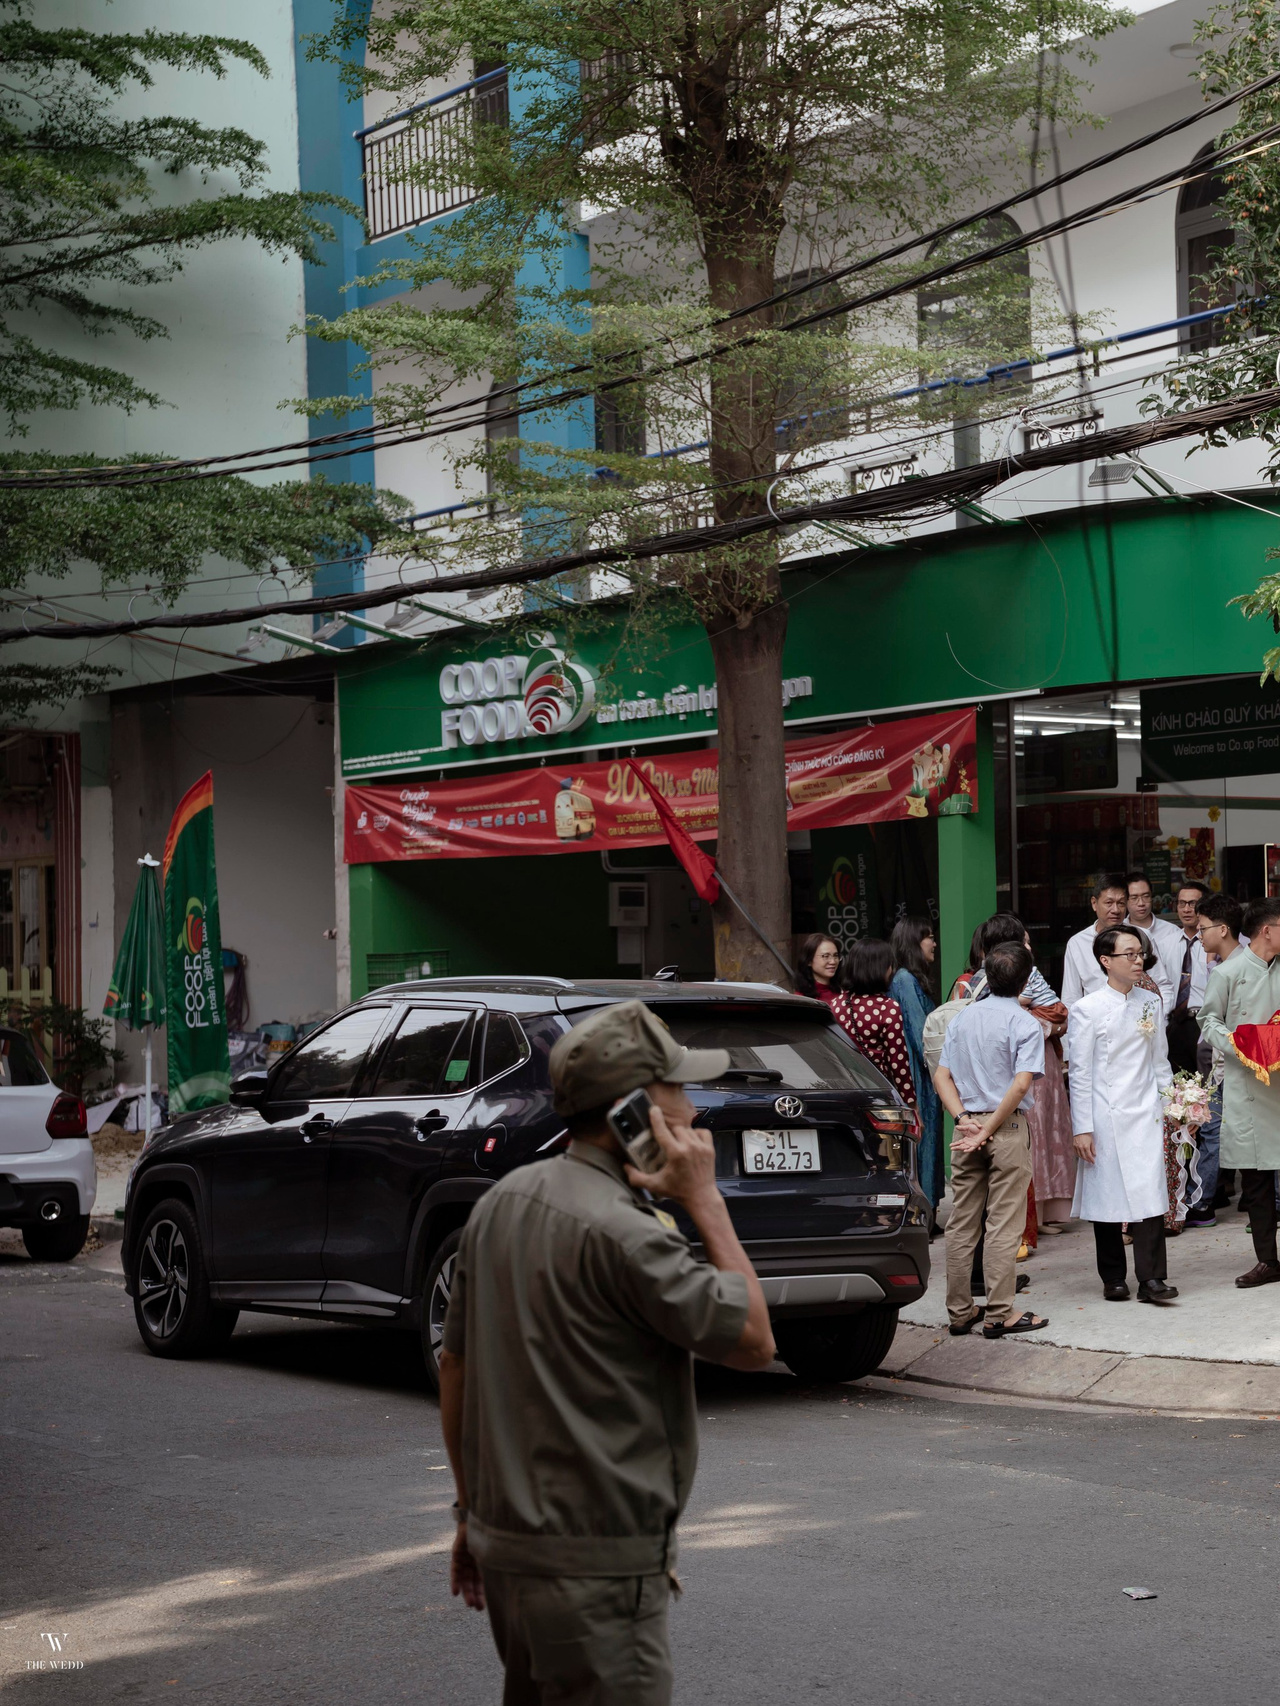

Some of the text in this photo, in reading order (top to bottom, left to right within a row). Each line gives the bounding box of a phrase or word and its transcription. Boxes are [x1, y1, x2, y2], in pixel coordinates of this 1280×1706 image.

[441, 700, 526, 749] FOOD
[1152, 712, 1181, 732] KÍNH
[1185, 707, 1220, 728] CHÀO
[1224, 702, 1251, 725] QUÝ
[1174, 735, 1279, 757] Welcome to Co.op Food
[193, 954, 209, 1028] FOOD
[754, 1152, 814, 1171] 842.73
